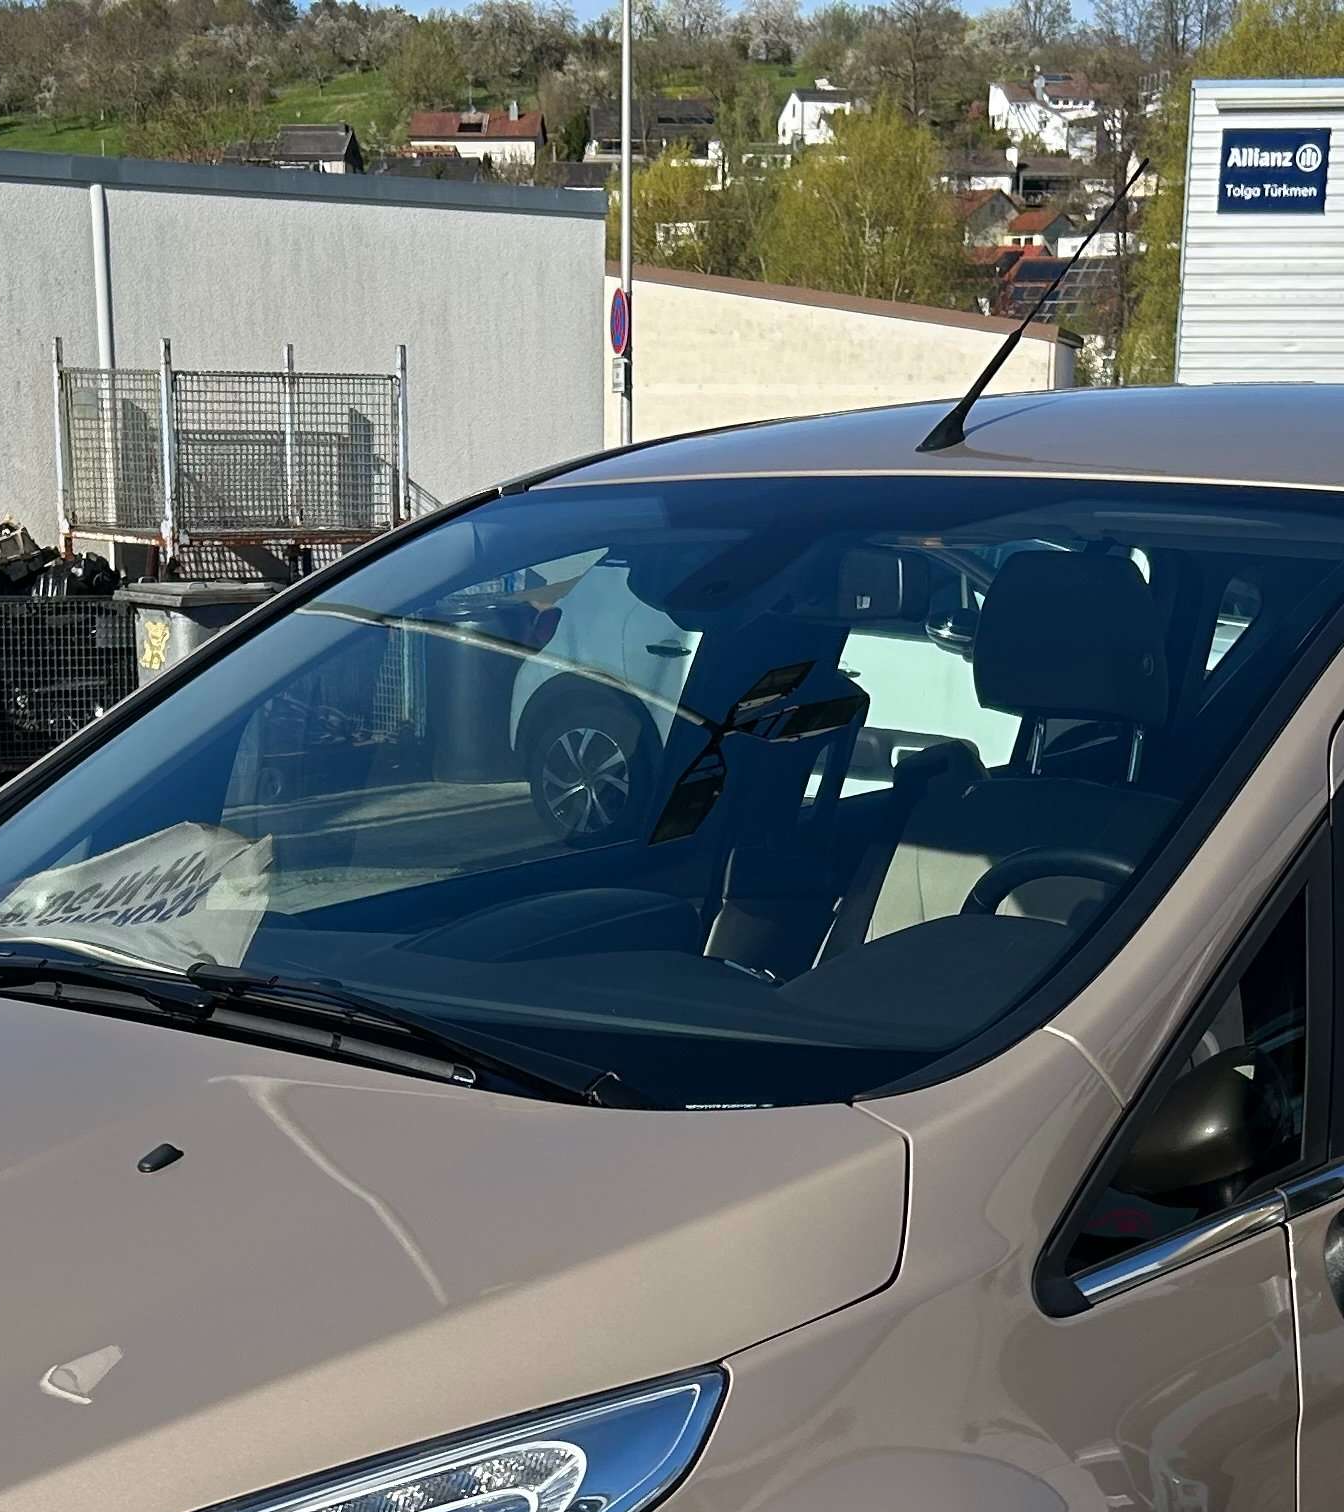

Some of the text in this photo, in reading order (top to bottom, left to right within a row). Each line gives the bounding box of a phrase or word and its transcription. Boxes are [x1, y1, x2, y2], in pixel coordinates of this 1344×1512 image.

[1227, 147, 1294, 168] Allianz
[1225, 183, 1318, 200] Tolga Türkmen
